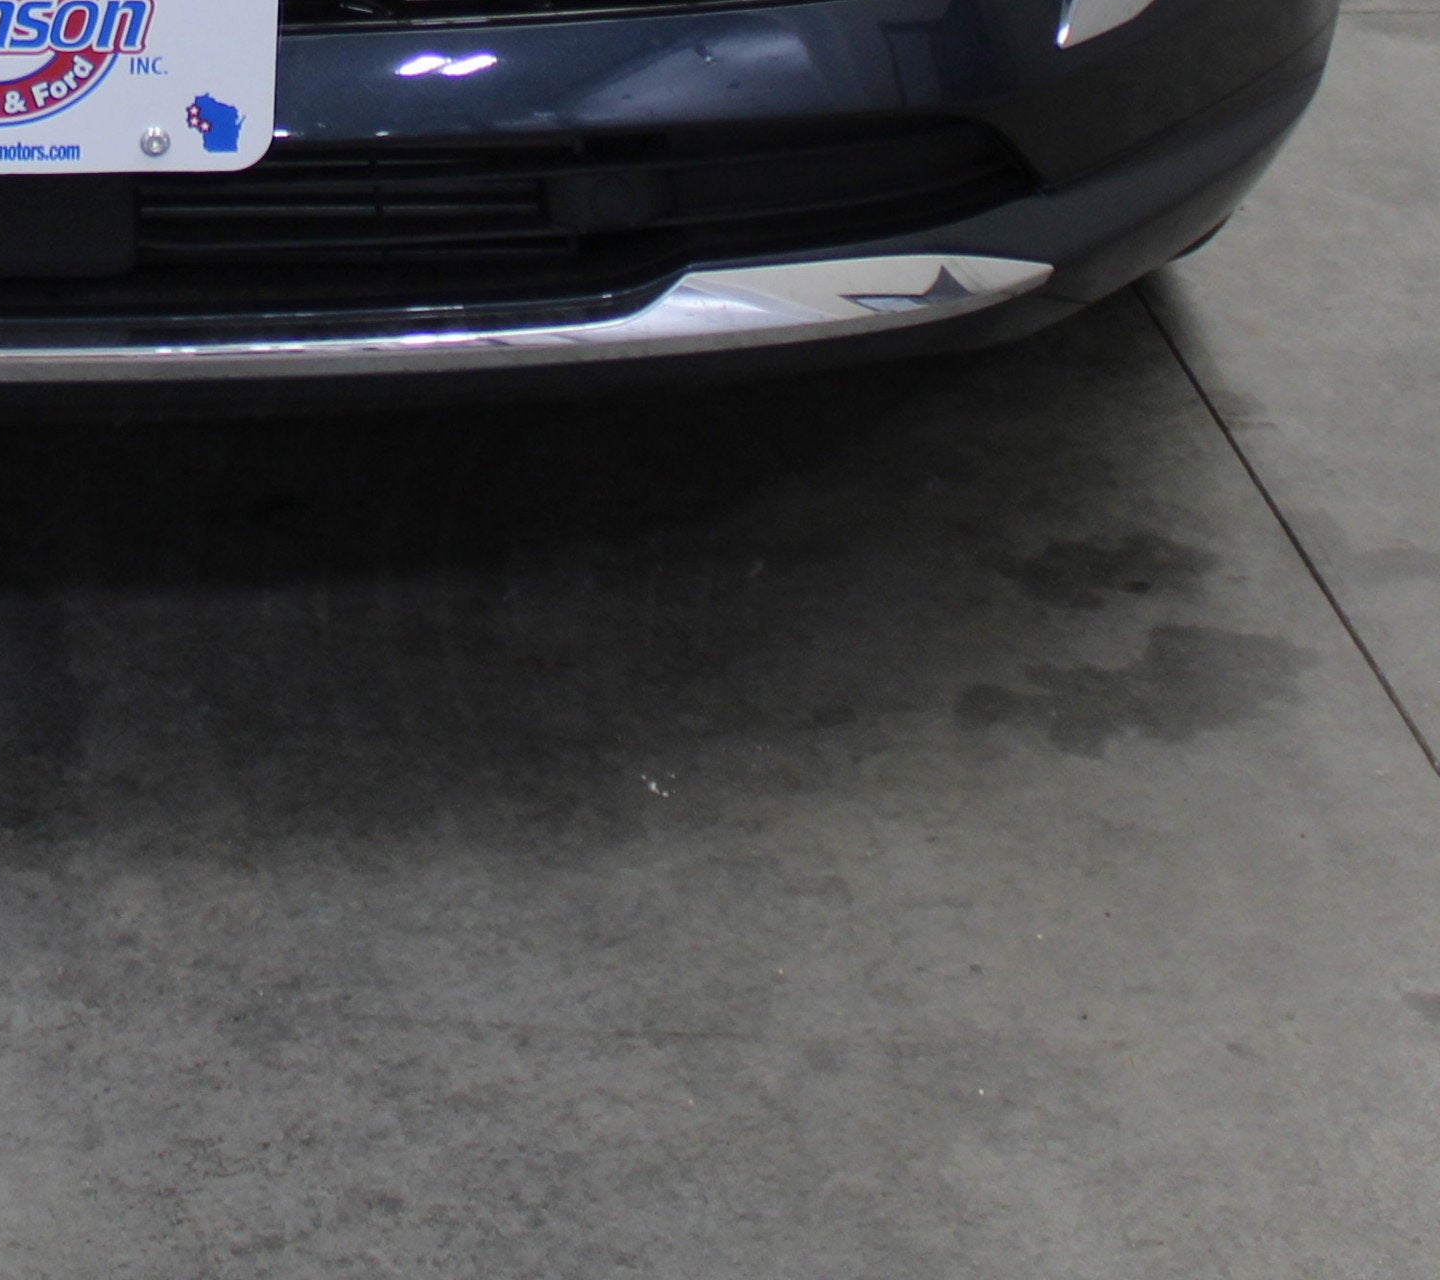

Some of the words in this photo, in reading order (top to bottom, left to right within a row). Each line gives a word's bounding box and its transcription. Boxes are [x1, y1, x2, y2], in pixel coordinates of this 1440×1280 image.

[4, 93, 26, 114] &
[31, 56, 94, 109] Ford
[129, 56, 168, 76] INC.
